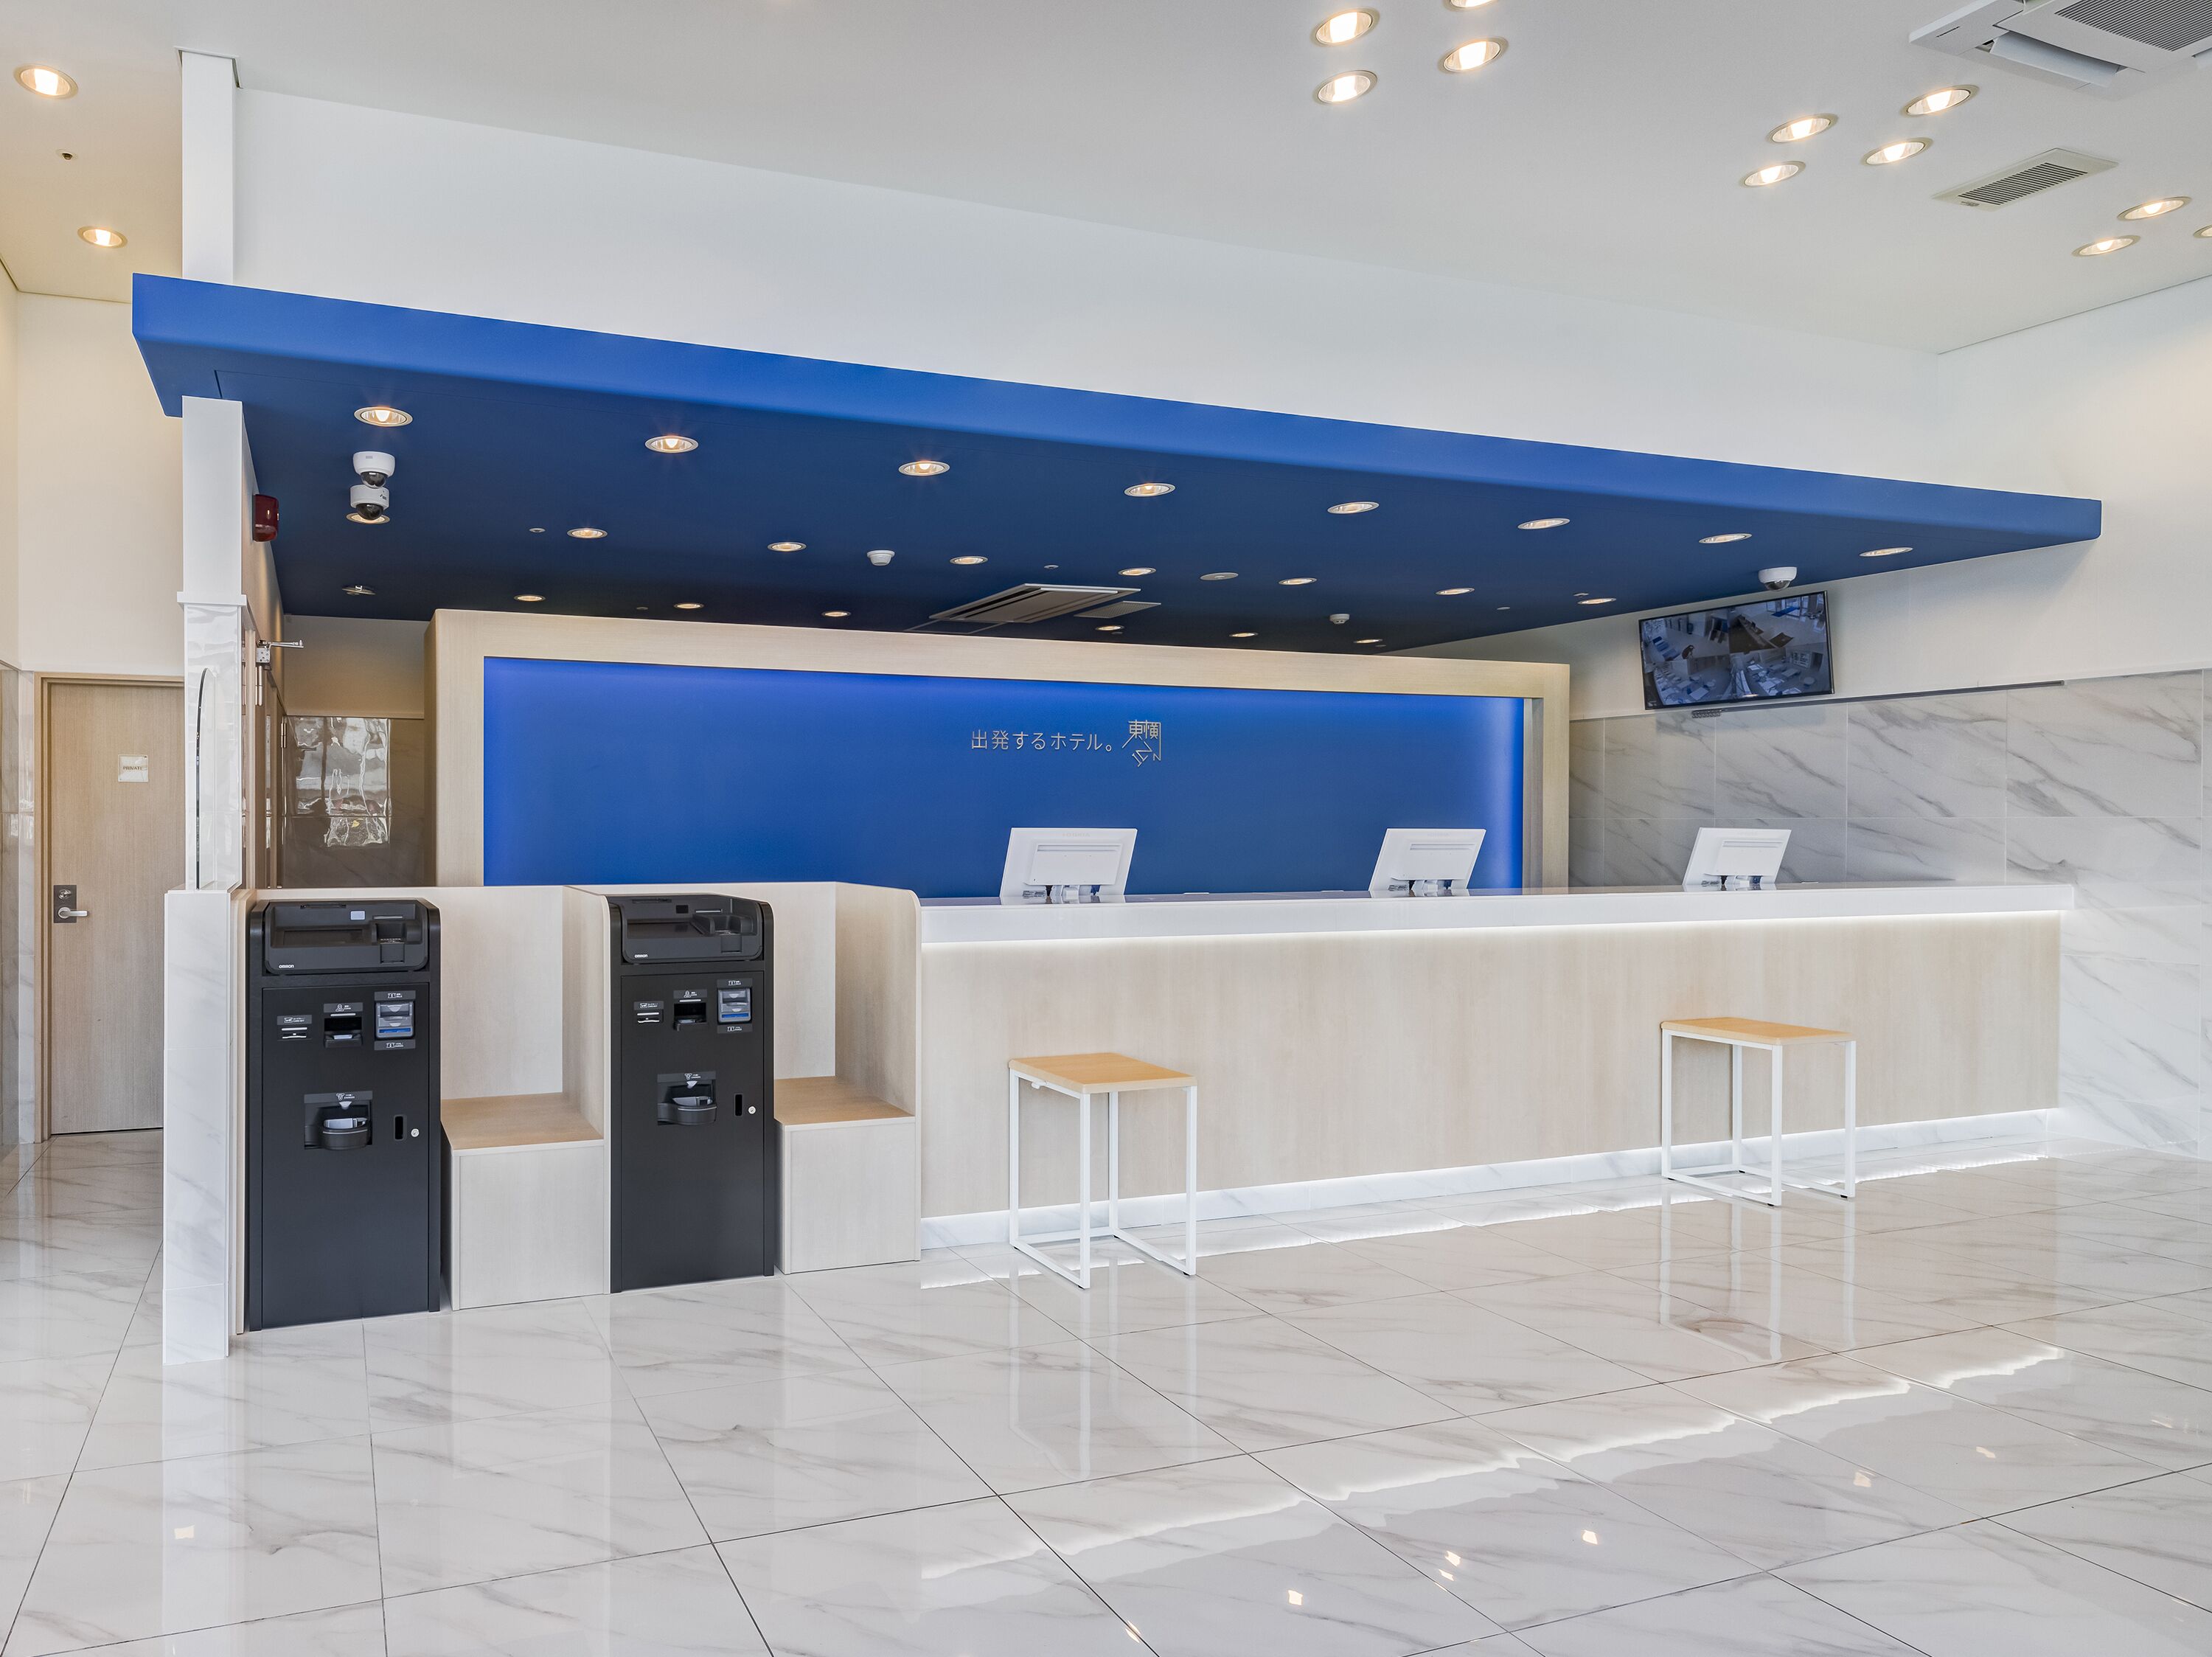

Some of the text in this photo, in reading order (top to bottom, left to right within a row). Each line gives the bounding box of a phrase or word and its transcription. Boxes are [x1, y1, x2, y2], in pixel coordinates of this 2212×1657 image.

[971, 729, 1112, 751] 出発するホテル。
